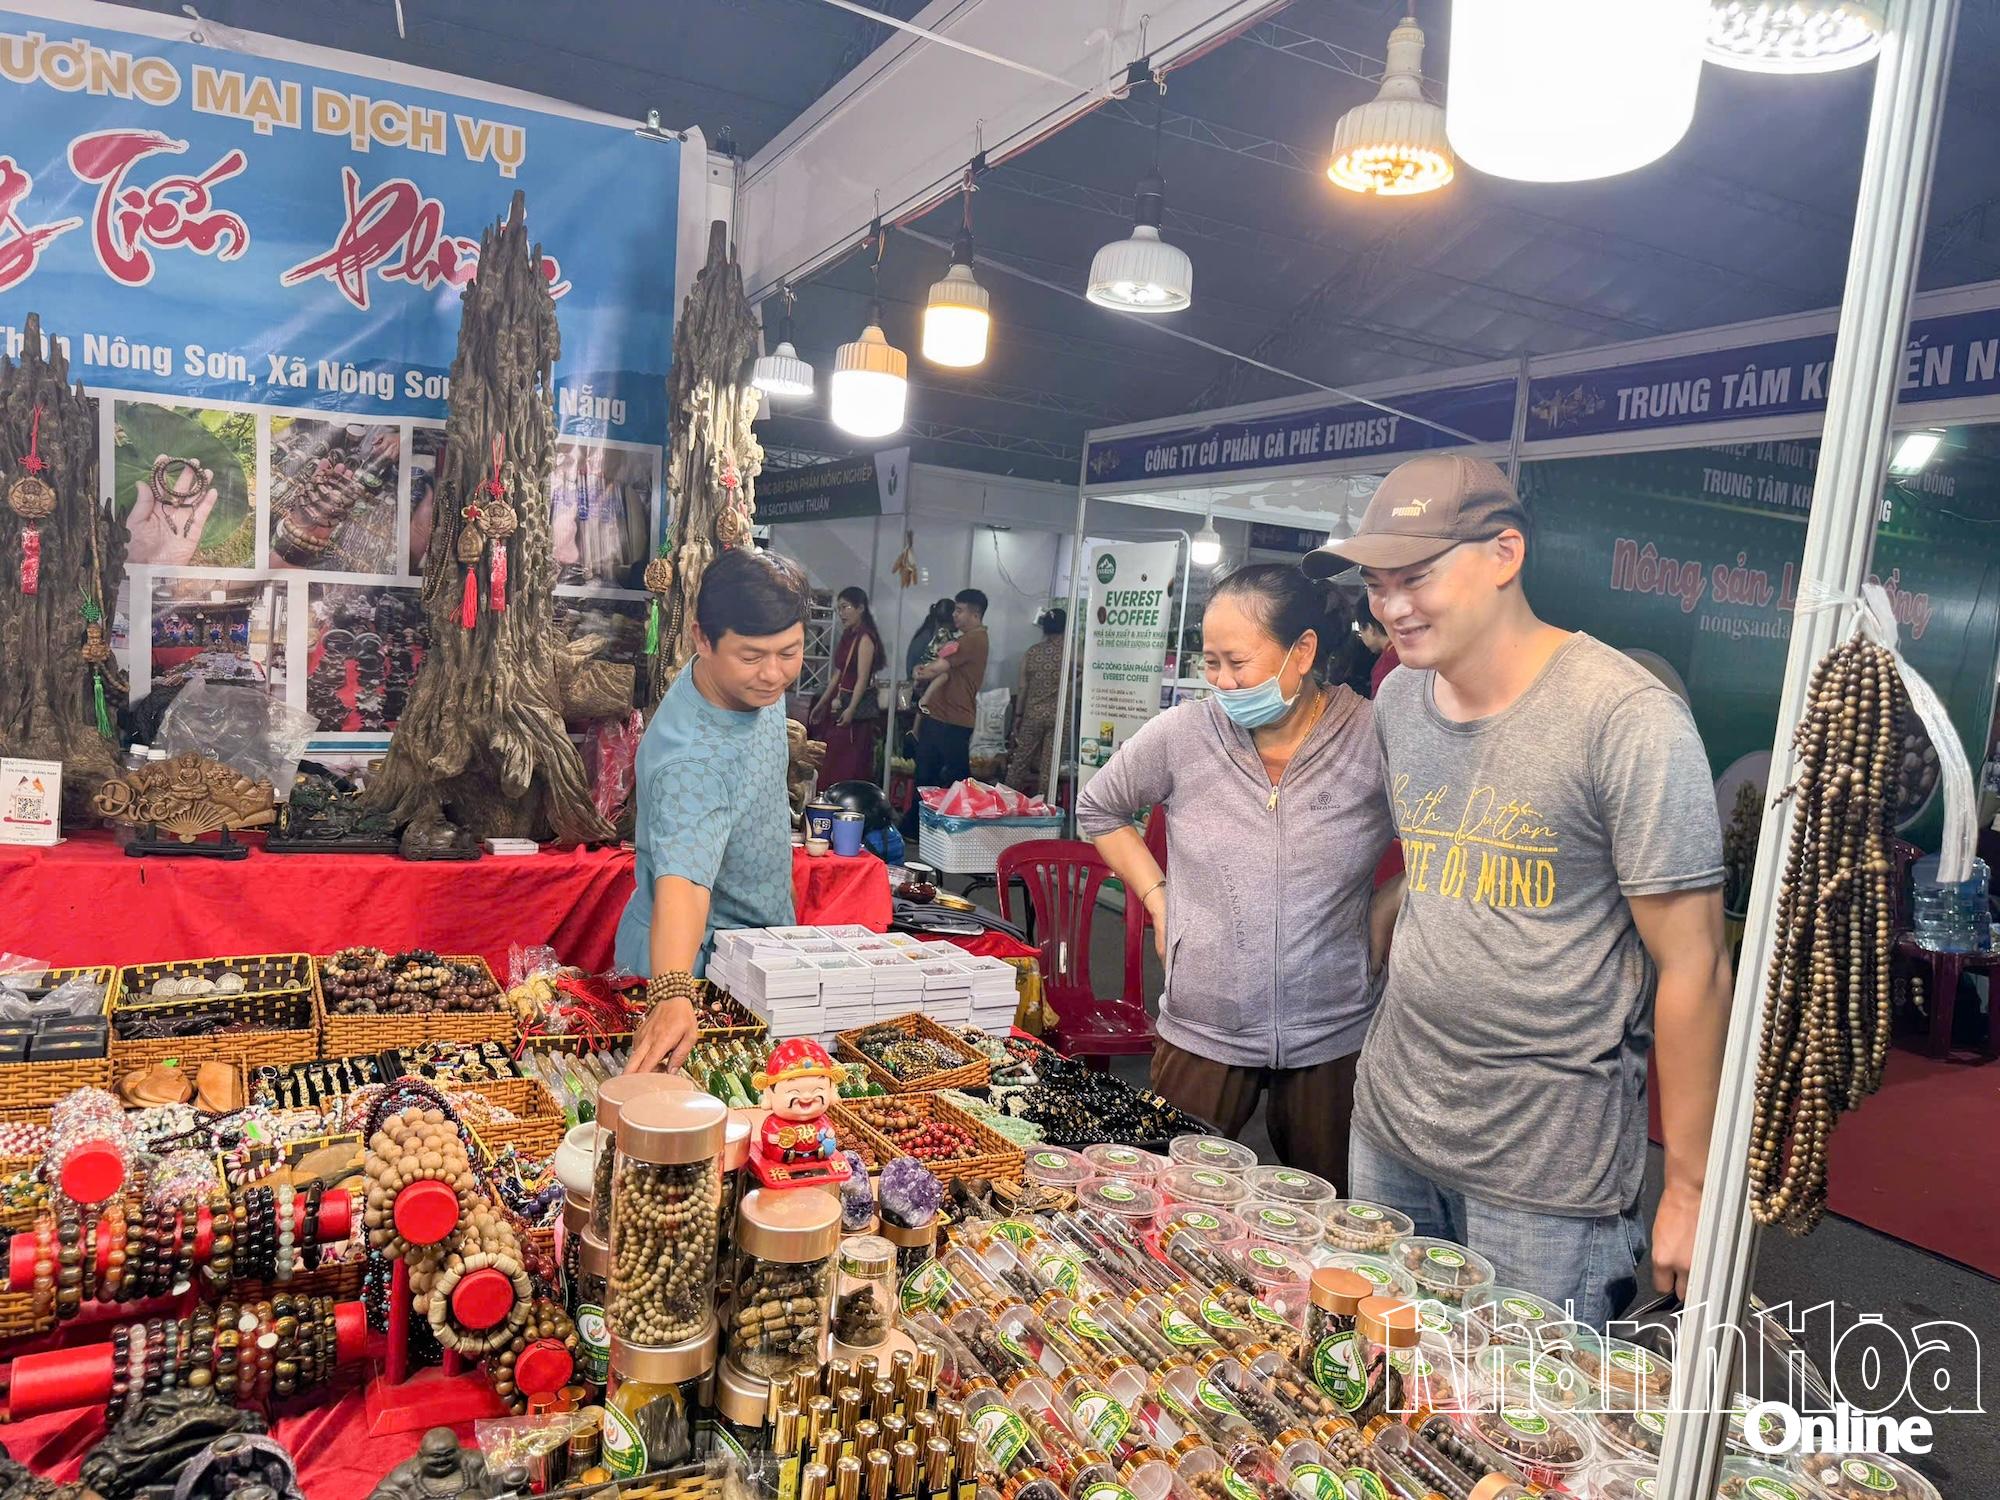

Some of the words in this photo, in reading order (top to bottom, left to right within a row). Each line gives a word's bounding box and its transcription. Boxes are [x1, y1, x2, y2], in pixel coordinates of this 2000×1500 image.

[192, 64, 301, 136] MẠI
[313, 87, 446, 153] DỊCH
[454, 114, 526, 179] VỤ
[84, 333, 172, 376] Nông
[184, 344, 256, 386] Sơn,
[267, 353, 307, 388] Xã
[317, 359, 394, 400] Nông
[1616, 378, 1712, 421] TRUNG
[1721, 364, 1791, 409] TÂM
[1965, 339, 2000, 382] N
[1145, 446, 1177, 472] CÔNG
[1181, 444, 1197, 468] TY
[1200, 433, 1219, 466] CỔ
[1222, 429, 1261, 463] PHẦN
[1264, 429, 1285, 459] CÀ
[1289, 422, 1321, 455] PHÊ
[1324, 416, 1400, 451] EVEREST
[820, 471, 842, 487] NÔNG
[843, 463, 873, 484] NGHIỆP
[1703, 467, 1752, 499] TRUNG
[1757, 475, 1788, 503] TÂM
[806, 494, 830, 515] THUẬN
[1391, 506, 1421, 517] PUMA
[1610, 537, 1706, 613] Nông
[1712, 551, 1773, 607] sản
[1105, 590, 1163, 607] EVEREST
[1107, 609, 1159, 626] COFFEE
[1701, 612, 1791, 640] nongsanda
[1092, 660, 1104, 670] CÁC
[1105, 662, 1121, 671] DÒNG
[1122, 661, 1134, 671] SẢN
[1135, 660, 1153, 672] PHẨM
[1103, 672, 1125, 682] EVEREST
[1126, 673, 1149, 683] COFFEE
[1473, 851, 1556, 908] MIND
[1235, 920, 1249, 951] NEW
